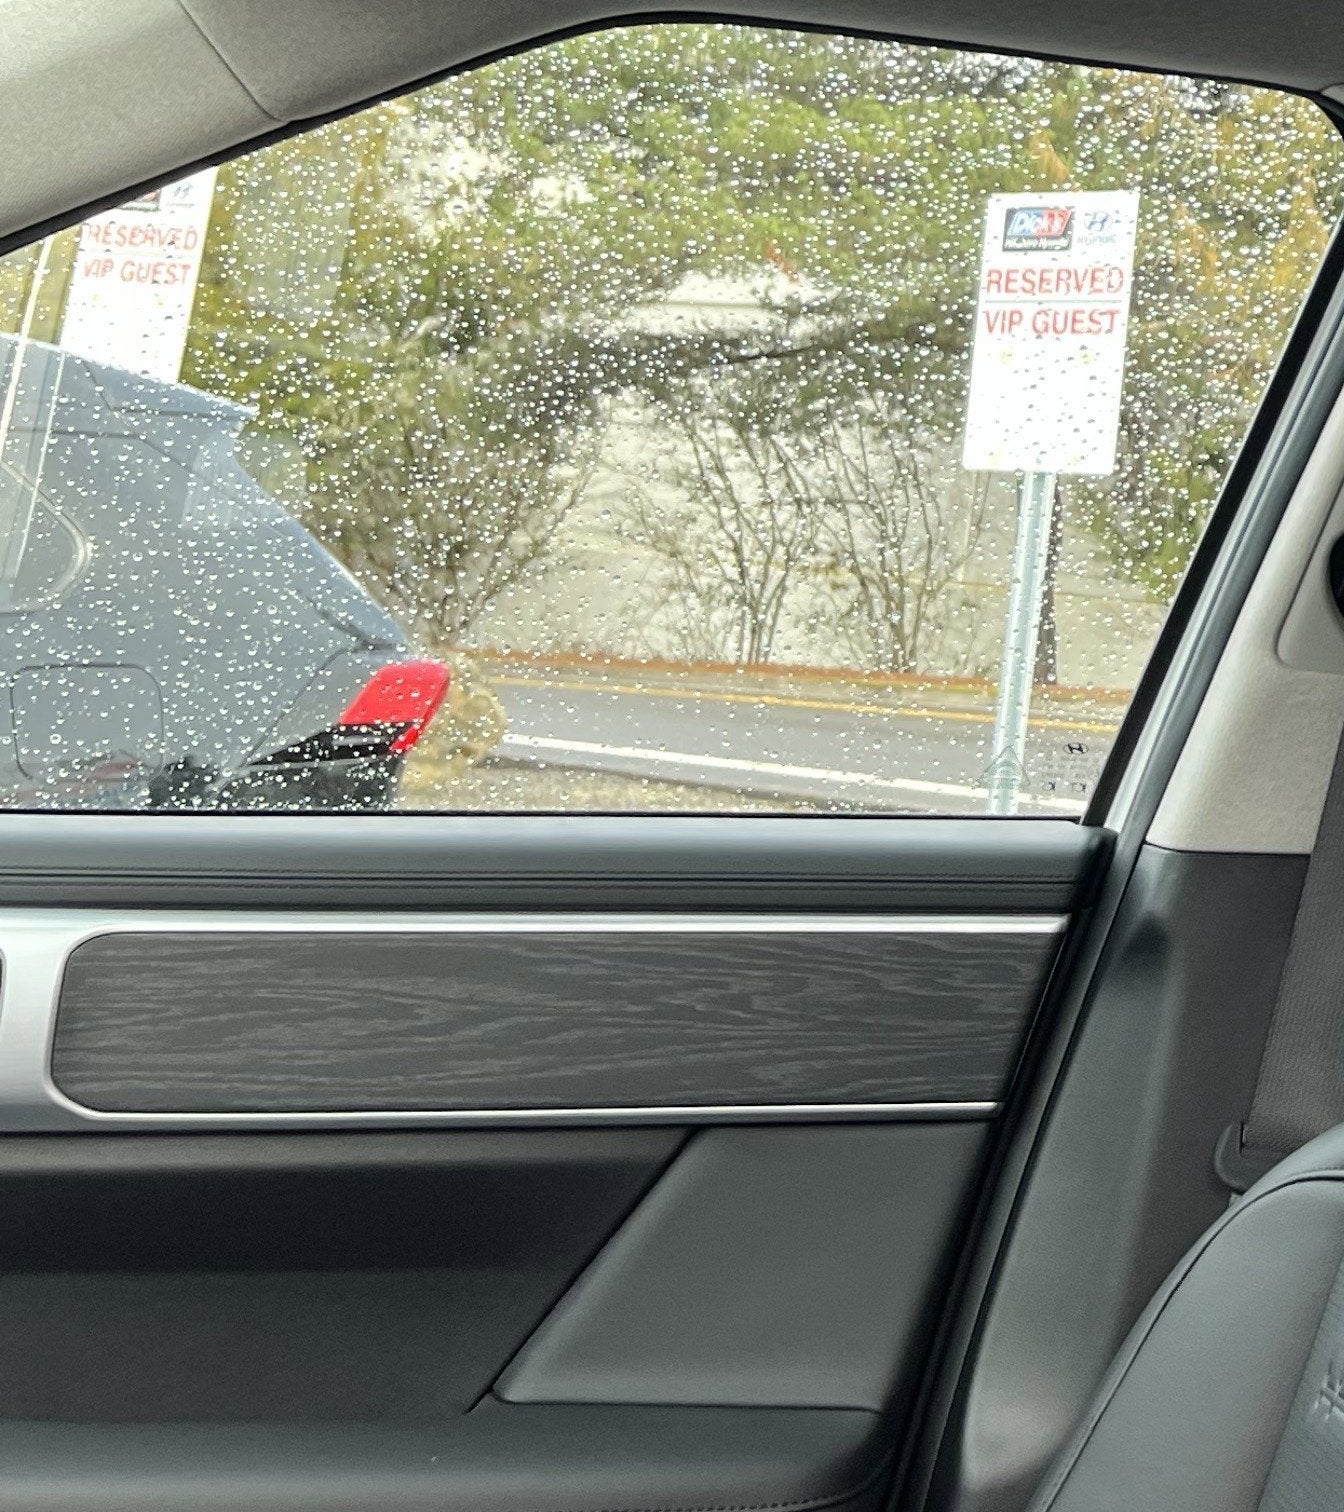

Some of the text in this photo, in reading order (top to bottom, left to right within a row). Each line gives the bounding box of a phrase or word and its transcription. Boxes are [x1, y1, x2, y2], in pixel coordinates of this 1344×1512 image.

[88, 223, 198, 250] RESERVED
[84, 257, 115, 279] VIP
[120, 259, 191, 285] GUEST
[986, 266, 1124, 294] RESERVED
[984, 309, 1023, 334] VIP
[1032, 308, 1121, 335] GUEST
